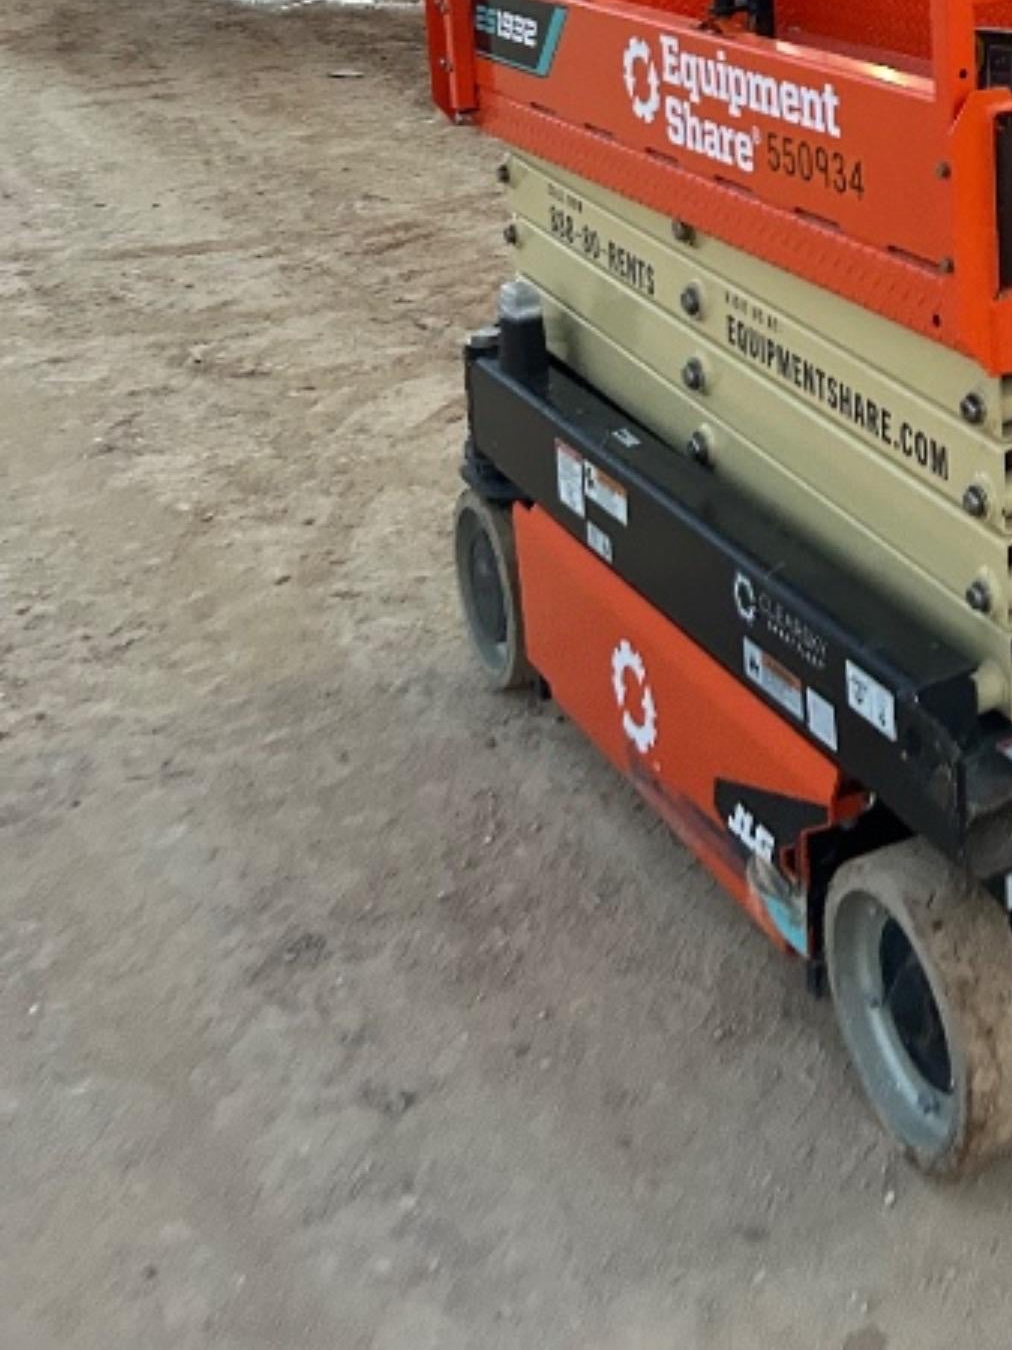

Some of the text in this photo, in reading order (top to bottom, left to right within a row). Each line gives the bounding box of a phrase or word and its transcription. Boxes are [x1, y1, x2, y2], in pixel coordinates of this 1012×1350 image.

[659, 34, 842, 139] Equipment
[665, 95, 755, 173] Share
[767, 132, 866, 200] 550934
[726, 314, 950, 482] EQUIPMENTSHARE.COM
